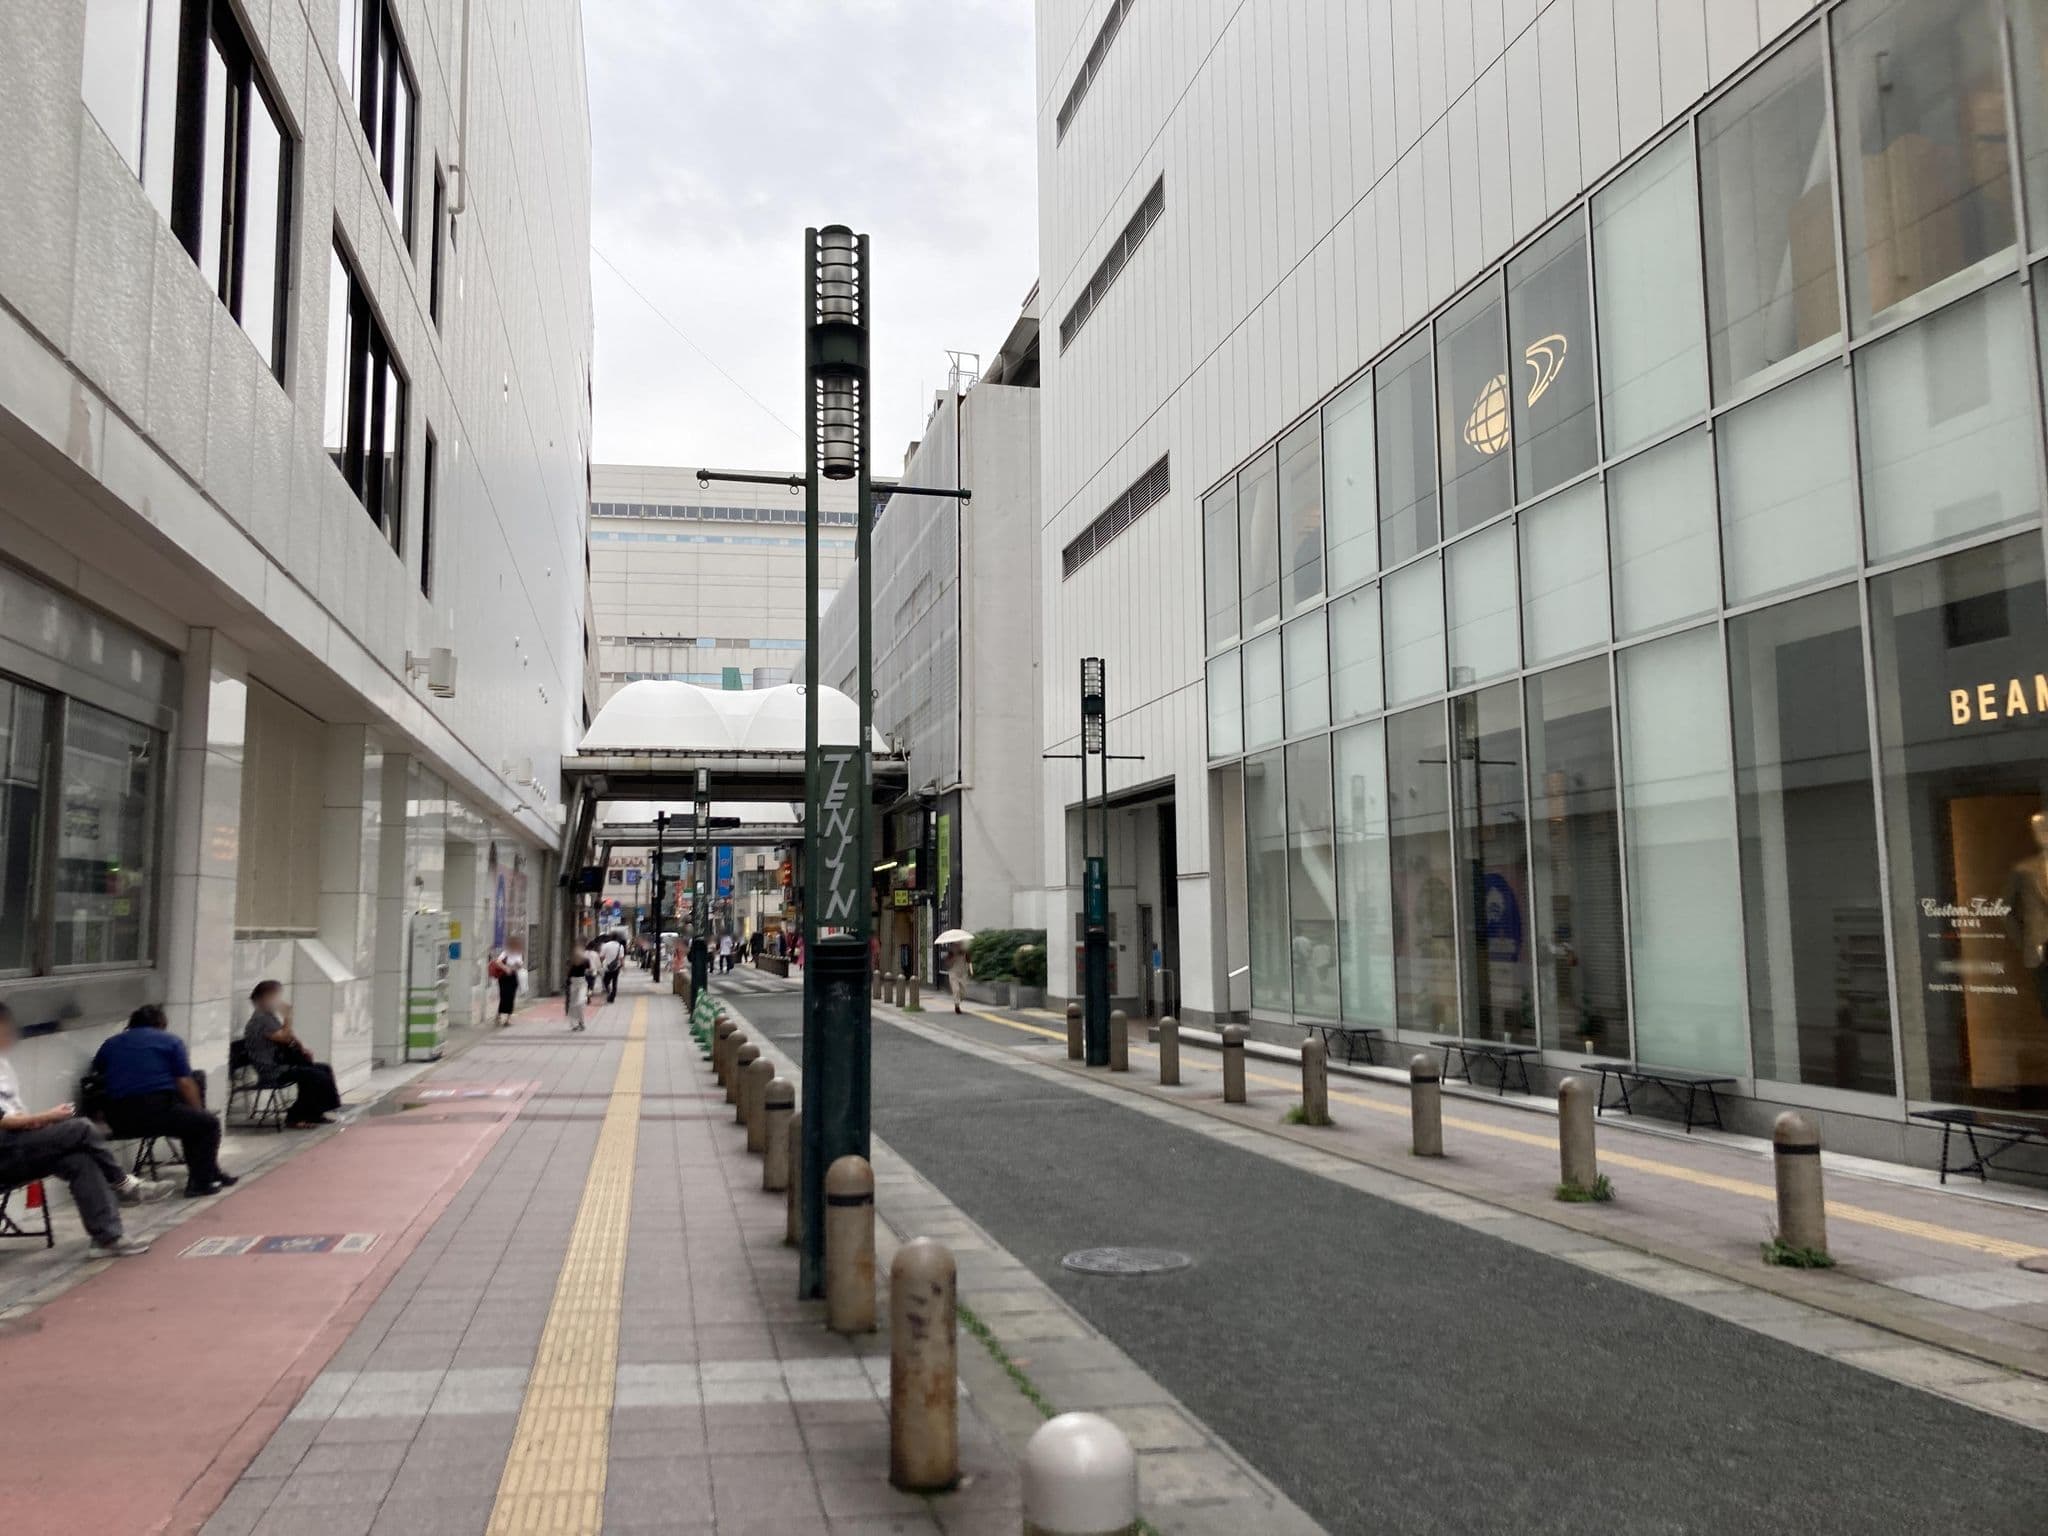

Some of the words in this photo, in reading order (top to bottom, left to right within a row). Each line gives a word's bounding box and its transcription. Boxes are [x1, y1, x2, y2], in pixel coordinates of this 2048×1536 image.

[823, 753, 856, 920] TENJIN
[1921, 898, 1969, 917] Custom
[1969, 897, 2012, 917] Tailor
